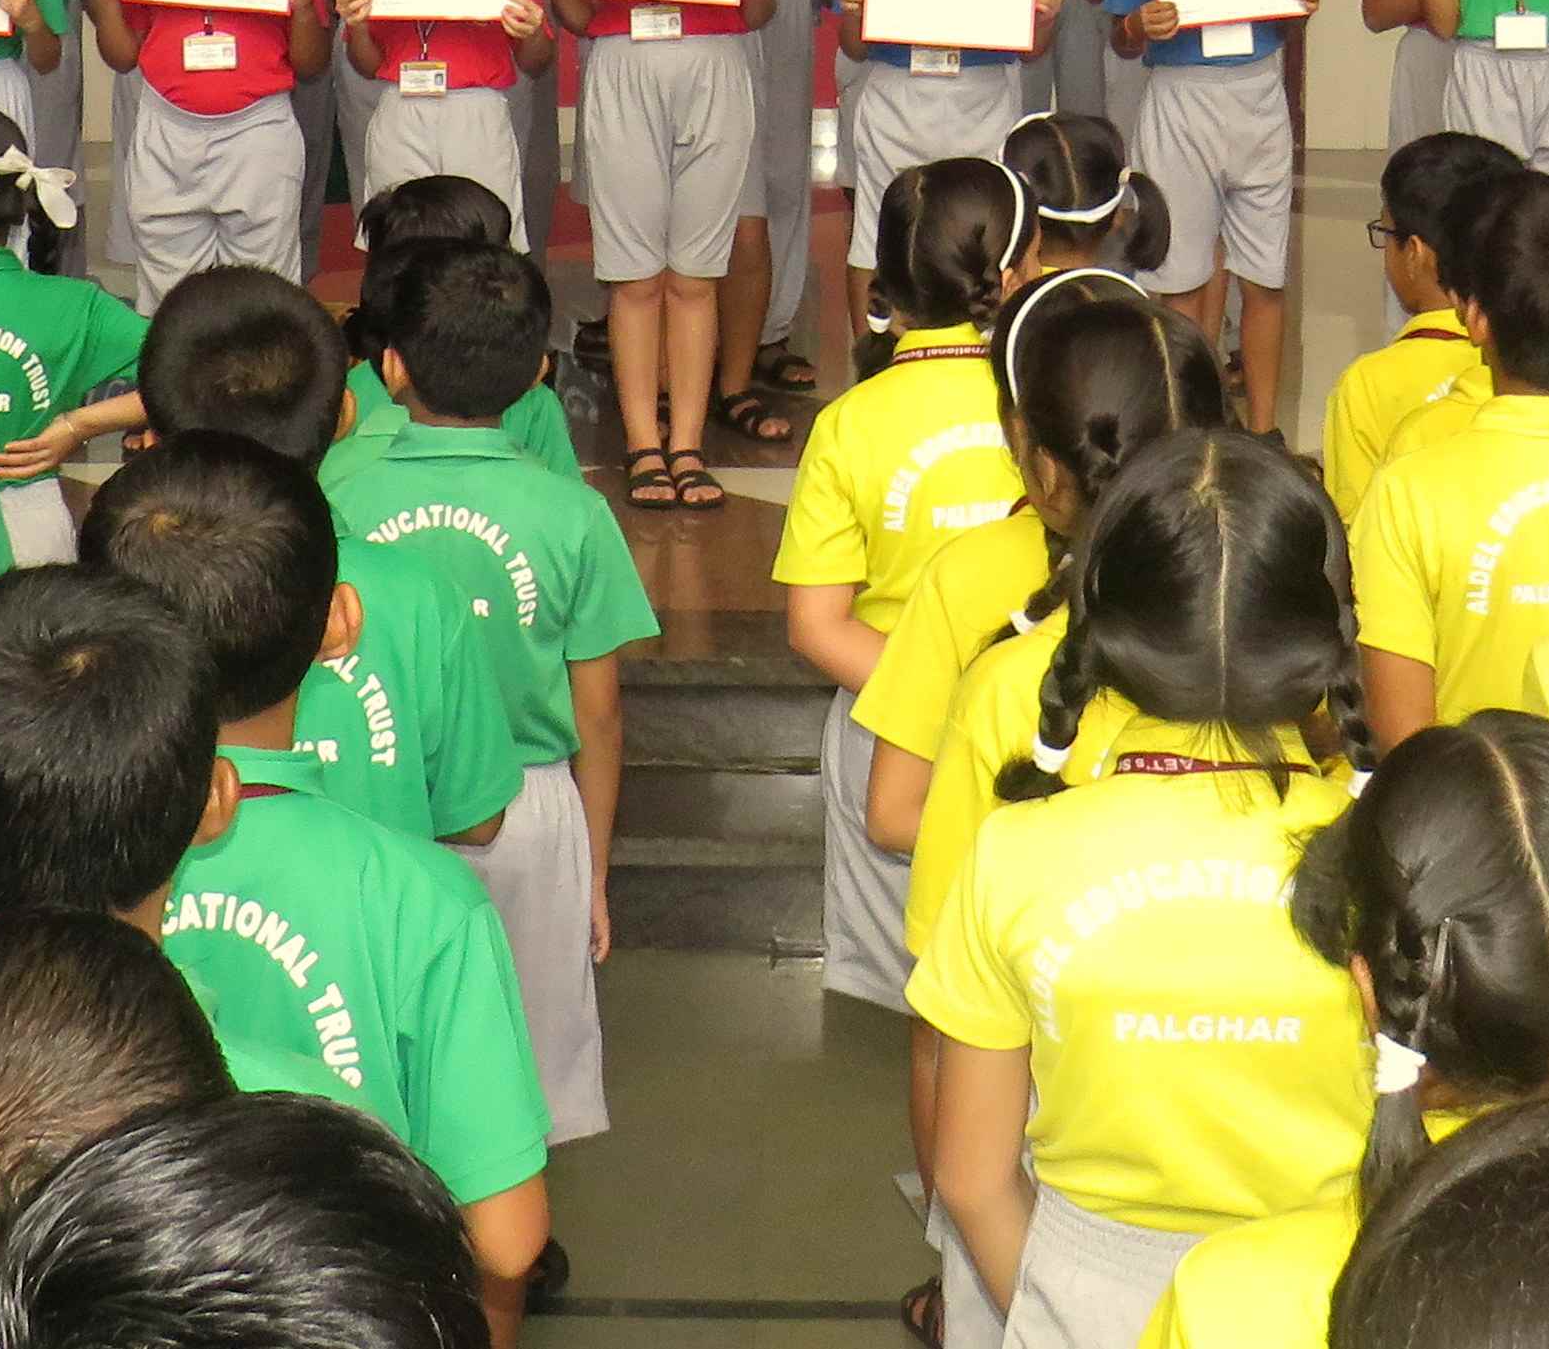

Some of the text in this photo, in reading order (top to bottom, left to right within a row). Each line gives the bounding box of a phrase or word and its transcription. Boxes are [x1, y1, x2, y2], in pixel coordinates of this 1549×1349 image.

[21, 353, 52, 413] TRUST
[365, 501, 539, 629] DUCATIONAL TRUST
[356, 671, 398, 767] TRUST
[160, 891, 325, 989] CATIONAL
[1112, 1011, 1303, 1046] PALGHAR
